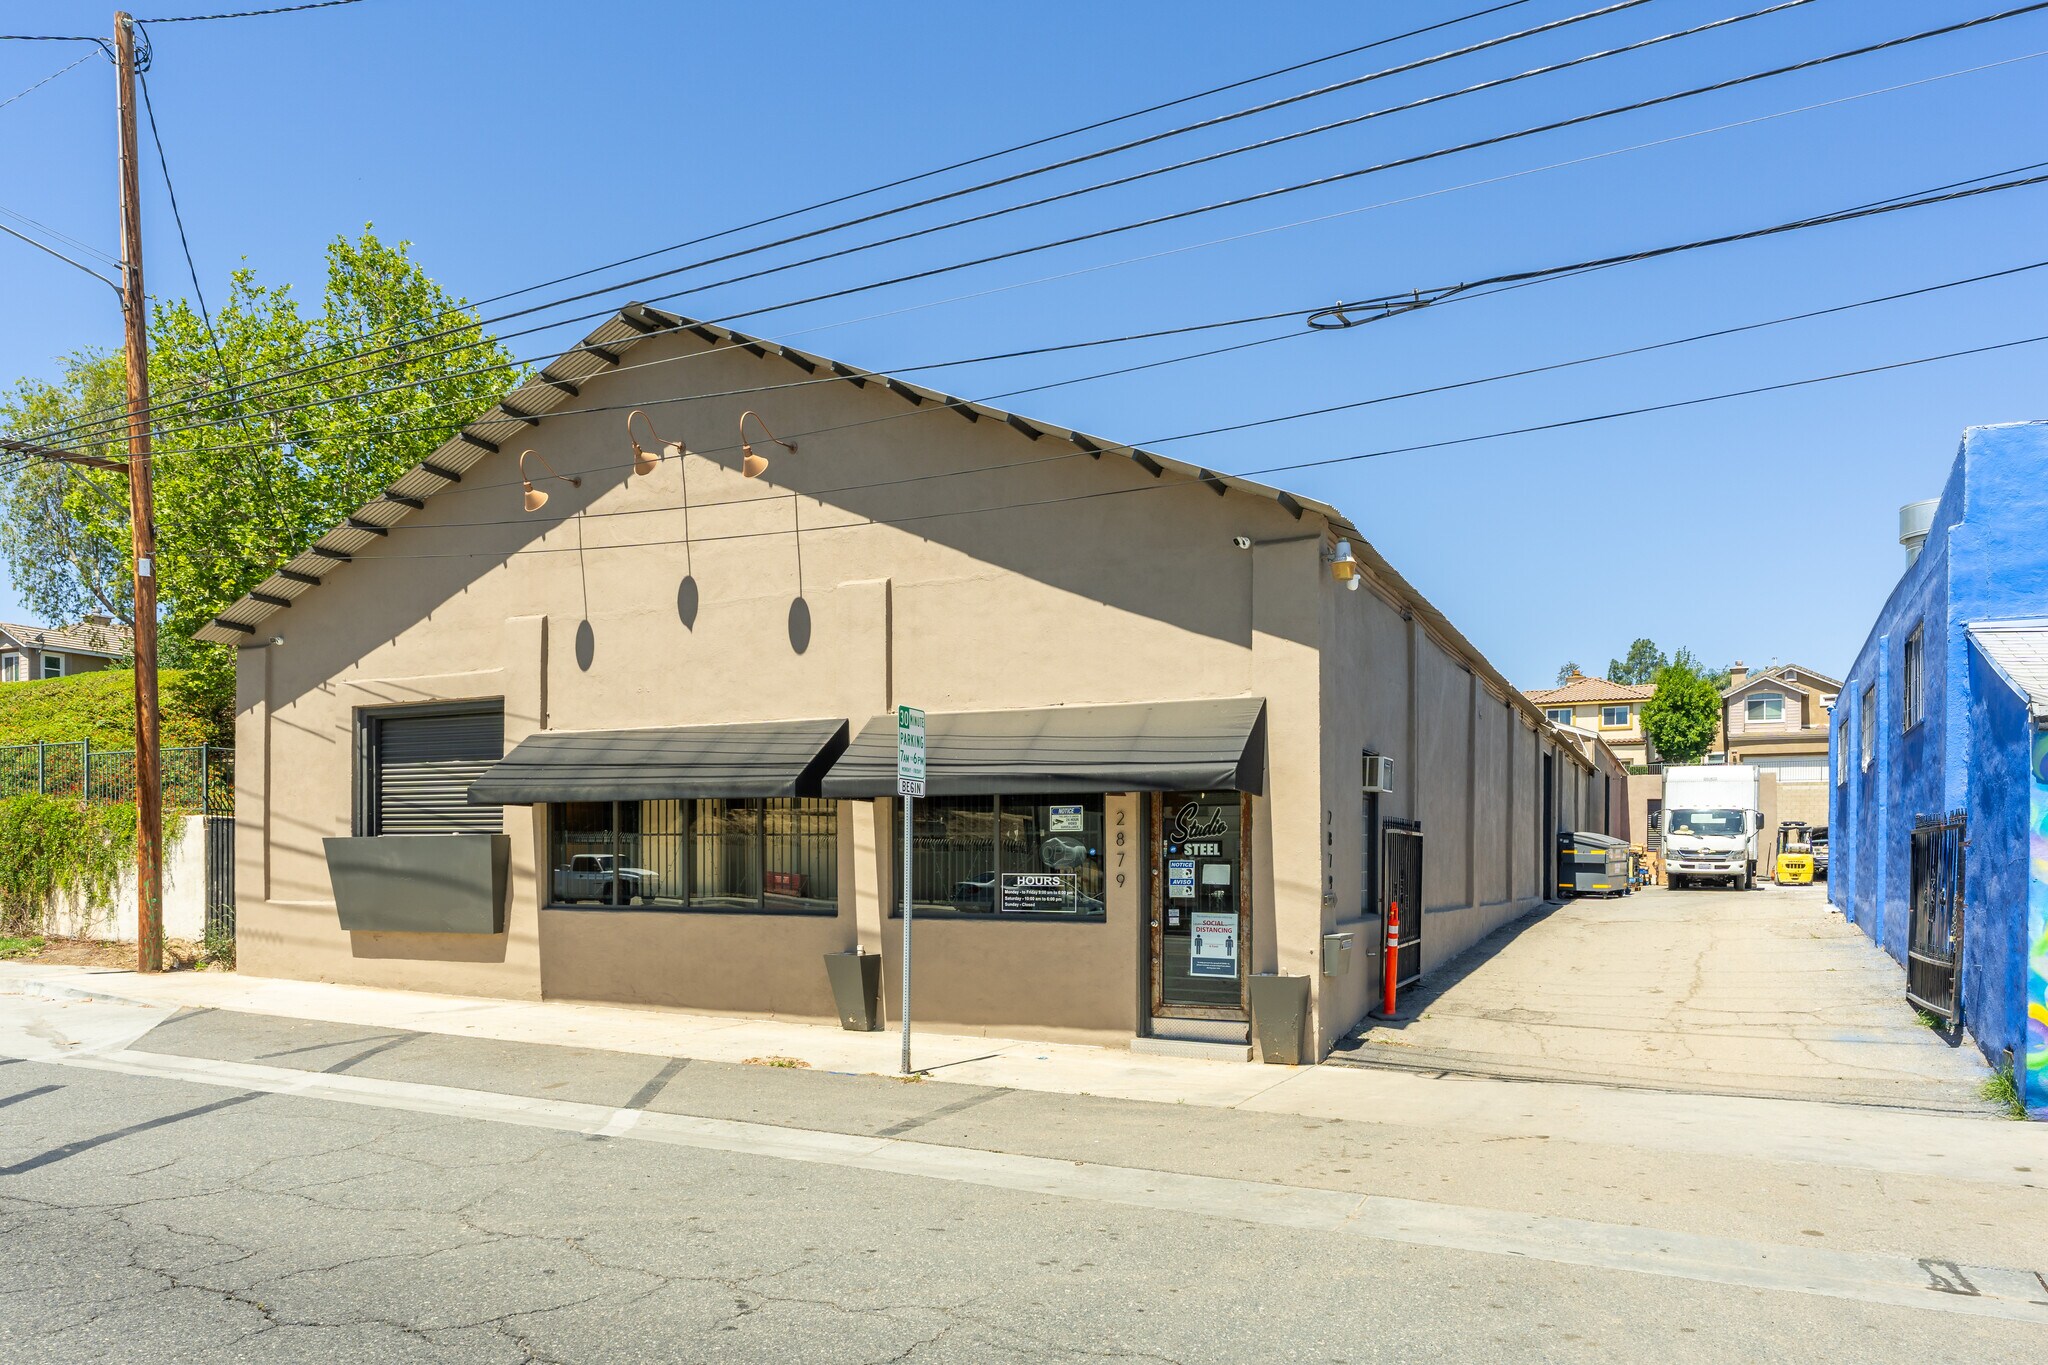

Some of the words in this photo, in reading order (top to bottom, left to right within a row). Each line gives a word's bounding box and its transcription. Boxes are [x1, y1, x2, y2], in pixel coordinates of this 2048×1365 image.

[900, 710, 909, 726] 30
[910, 714, 924, 728] MINUTE
[900, 732, 924, 749] PARKING
[902, 781, 921, 794] BEGIN
[1170, 801, 1228, 844] Studio
[1116, 811, 1126, 888] 2879
[1183, 843, 1220, 856] STEEL
[1017, 876, 1060, 885] HOURS
